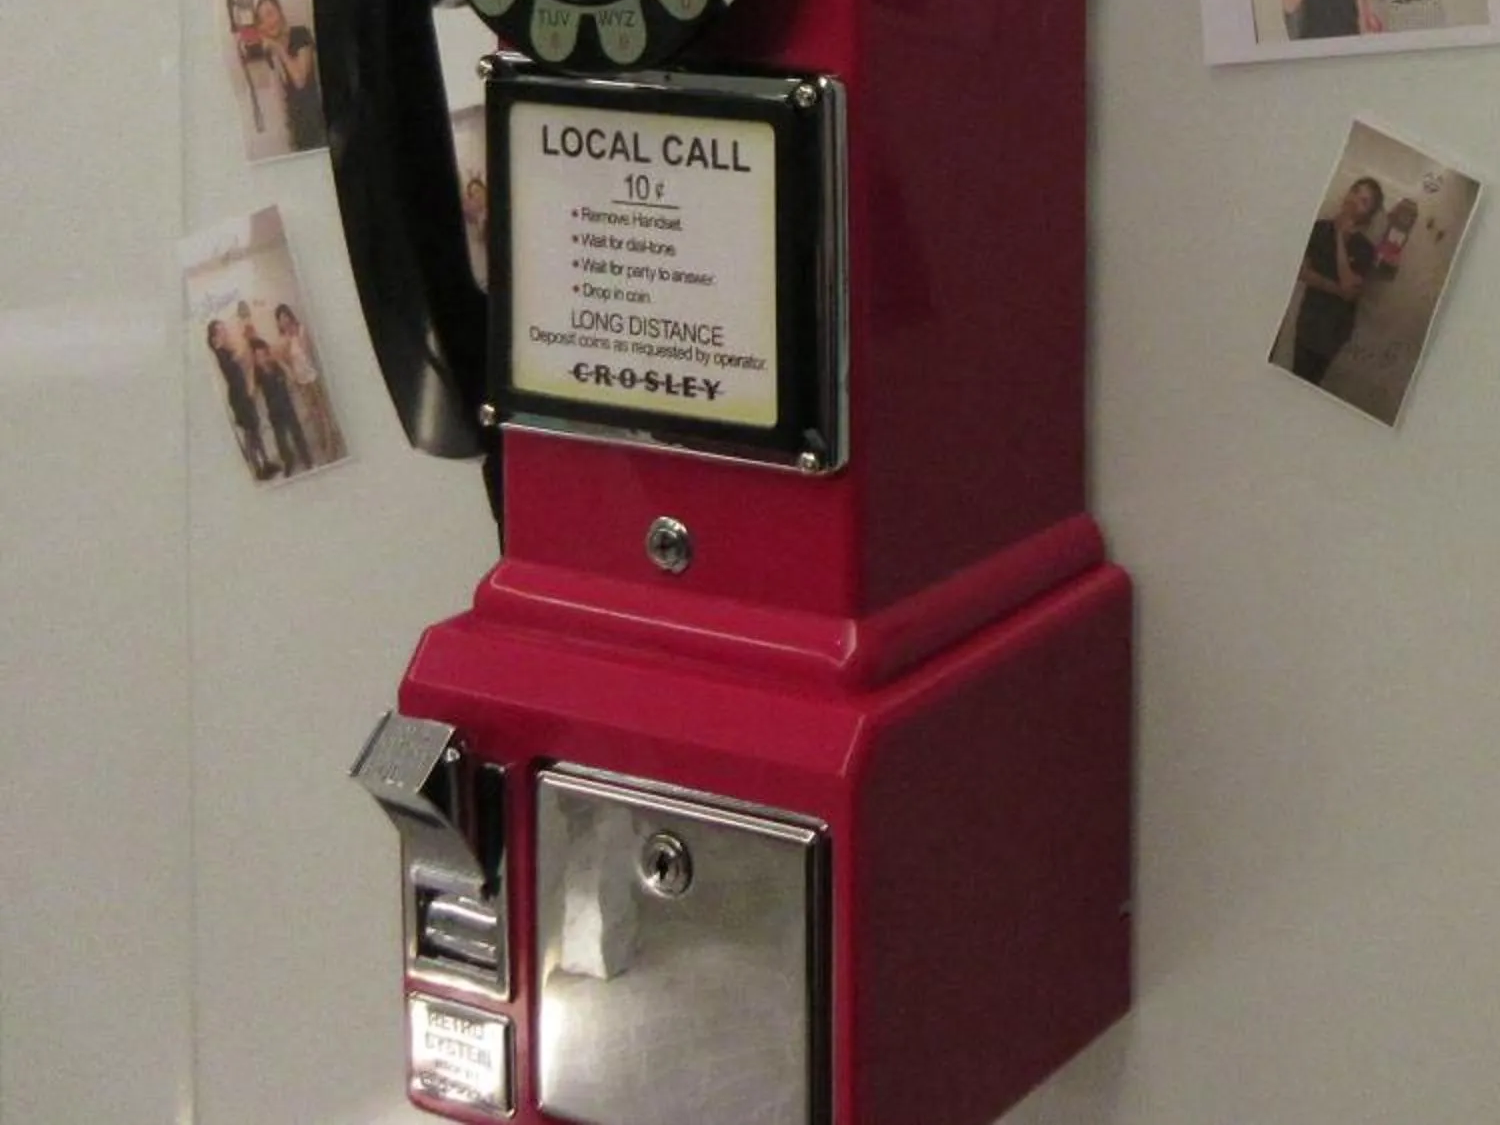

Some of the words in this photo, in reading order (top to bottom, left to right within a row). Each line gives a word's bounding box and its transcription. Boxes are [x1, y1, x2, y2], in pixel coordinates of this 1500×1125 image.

[538, 11, 571, 27] TUV
[542, 124, 652, 164] LOCAL
[662, 134, 752, 173] CALL
[624, 174, 650, 201] 10
[582, 207, 630, 227] Remove
[582, 233, 607, 249] Wait
[609, 234, 624, 250] for
[582, 257, 607, 275] Wait
[609, 259, 624, 276] for
[626, 264, 657, 283] party
[658, 266, 671, 281] to
[583, 283, 611, 301] Drop
[613, 286, 625, 300] in
[571, 308, 623, 334] LONG
[628, 314, 725, 348] DISTANCE
[529, 325, 577, 346] Deposit
[578, 336, 612, 352] coins
[613, 339, 629, 352] as
[631, 340, 693, 362] requested
[695, 347, 711, 366] by
[571, 362, 723, 402] CROSLEY
